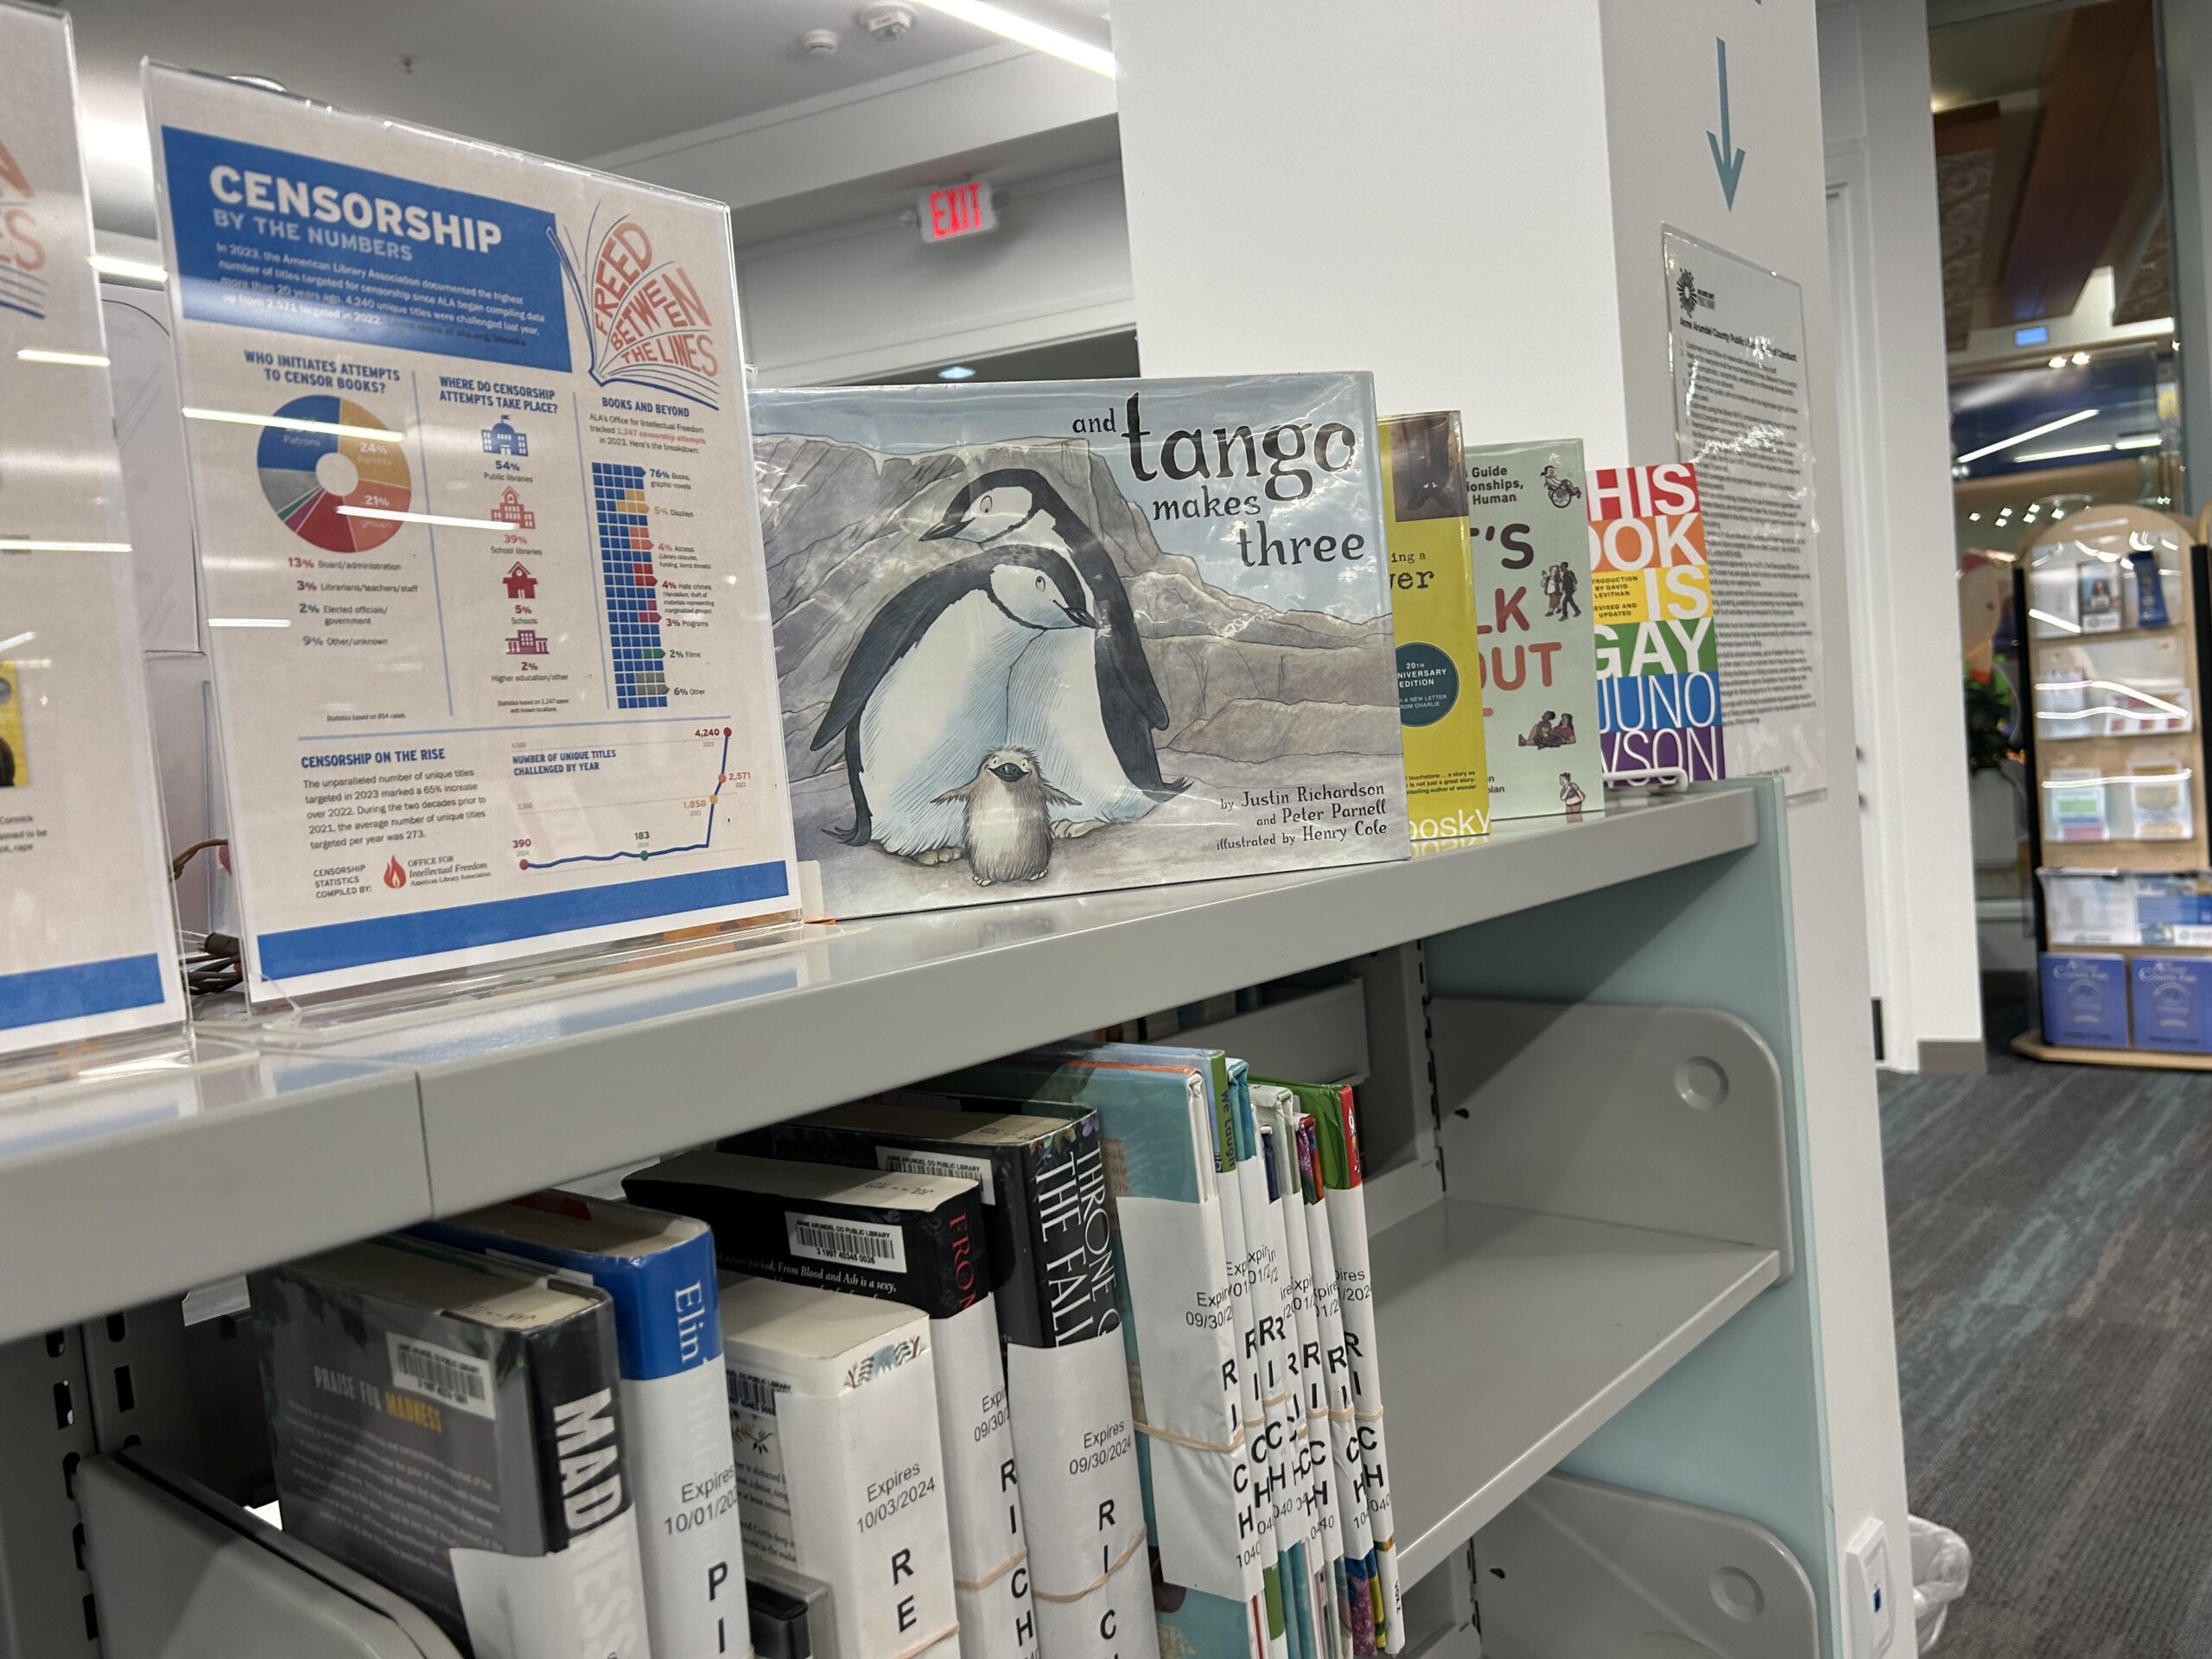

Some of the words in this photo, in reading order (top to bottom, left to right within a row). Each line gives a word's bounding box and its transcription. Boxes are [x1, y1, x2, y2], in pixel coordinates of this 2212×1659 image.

[209, 165, 502, 254] CENSORSHIP
[930, 181, 982, 239] EXIT
[213, 208, 244, 229] BY
[253, 215, 300, 241] THE
[308, 226, 413, 262] NUMBERS
[215, 242, 227, 253] In
[264, 251, 281, 262] the
[283, 254, 330, 270] American
[334, 263, 365, 278] Library
[368, 269, 420, 287] Association
[423, 280, 476, 296] documented
[479, 288, 492, 299] the
[493, 290, 523, 305] highest
[594, 221, 652, 336] FREED
[610, 266, 712, 351] BETWEEN
[245, 350, 273, 365] WHO
[277, 354, 336, 373] INITIATES
[340, 364, 400, 381] ATTEMPTS
[620, 341, 658, 365] THE
[656, 334, 718, 378] LINES
[264, 368, 281, 381] TO
[284, 370, 333, 387] CENSOR
[337, 378, 386, 394] BOOKS?
[439, 376, 474, 390] WHERE
[477, 380, 491, 392] DO
[493, 383, 555, 400] CENSORSHIP
[440, 391, 493, 407] ATTEMPTS
[496, 397, 521, 410] TAKE
[524, 400, 558, 414] PLACE?
[602, 397, 632, 410] BOOKS
[635, 401, 653, 413] AND
[656, 403, 690, 417] BEYOND
[359, 442, 388, 454] 24%
[1072, 408, 1116, 434] and
[1121, 391, 1356, 502] tango
[495, 460, 520, 471] 54%
[649, 468, 671, 479] 76%
[1471, 467, 1508, 478] Guide
[1153, 486, 1261, 521] makes
[1472, 493, 1516, 505] Human
[504, 534, 528, 545] 39%
[1236, 520, 1365, 568] three
[288, 557, 315, 568] 13%
[296, 581, 317, 591] 3%
[1594, 590, 1630, 599] LEVITHAN
[1644, 564, 1708, 621] IS
[299, 603, 319, 613] 2%
[1477, 587, 1529, 634] K
[1599, 610, 1632, 619] UPDATED
[1594, 617, 1713, 680] GAY
[673, 687, 689, 696] 6%
[1399, 678, 1434, 688] EDITION
[1599, 671, 1716, 734] JUNO
[695, 728, 720, 739] 4,240
[302, 752, 372, 768] CENSORSHIP
[375, 751, 391, 764] ON
[395, 749, 417, 762] THE
[421, 747, 446, 760] RISE
[512, 753, 545, 765] NUMBER
[547, 753, 558, 762] OF
[560, 751, 589, 762] UNIQUE
[591, 749, 616, 759] TITLES
[513, 765, 564, 776] CHALLENGED
[566, 763, 576, 772] BY
[578, 762, 600, 772] YEAR
[304, 779, 320, 790] The
[322, 776, 377, 788] unparalleled
[378, 772, 412, 782] number
[414, 772, 423, 780] of
[424, 770, 453, 781] unique
[454, 768, 474, 778] titles
[729, 772, 751, 781] 2,571
[305, 792, 342, 804] targeted
[344, 791, 353, 801] in
[354, 790, 379, 800] 2023
[381, 786, 415, 798] marked
[423, 785, 442, 795] 65%
[444, 782, 478, 793] increase
[1220, 798, 1234, 812] by
[1241, 790, 1290, 808] Justin
[1296, 782, 1384, 803] Richardson
[1256, 814, 1276, 826] and
[1282, 806, 1325, 824] Peter
[1332, 798, 1386, 819] Parnell
[512, 838, 531, 849] 390
[634, 831, 650, 841] 183
[1216, 833, 1276, 851] illustrated
[1281, 833, 1295, 846] by
[1302, 825, 1347, 842] Henry
[1354, 819, 1387, 836] Cole
[314, 864, 365, 877] CENSORSHIP
[408, 856, 436, 867] OFFICE
[438, 855, 454, 864] FOR
[409, 865, 453, 878] Intellectual
[454, 861, 487, 873] Freedom
[315, 875, 359, 888] STATISTICS
[315, 887, 358, 899] COMPILED
[359, 886, 372, 894] BY:
[1036, 1151, 1081, 1243] THE
[1077, 1140, 1117, 1302] THRONE
[778, 1262, 798, 1276] From
[800, 1265, 824, 1280] Blood
[825, 1270, 842, 1284] and
[842, 1273, 859, 1286] Ash
[861, 1275, 868, 1287] is
[868, 1280, 875, 1288] a
[876, 1279, 897, 1294] sexy,
[675, 1280, 705, 1363] Elin
[1084, 1421, 1124, 1450] Expires
[553, 1388, 623, 1533] MAD
[1070, 1435, 1131, 1475] 09/30/2024
[681, 1463, 734, 1504] Expires
[867, 1463, 920, 1503] Expires
[856, 1476, 936, 1535] 10/03/2024
